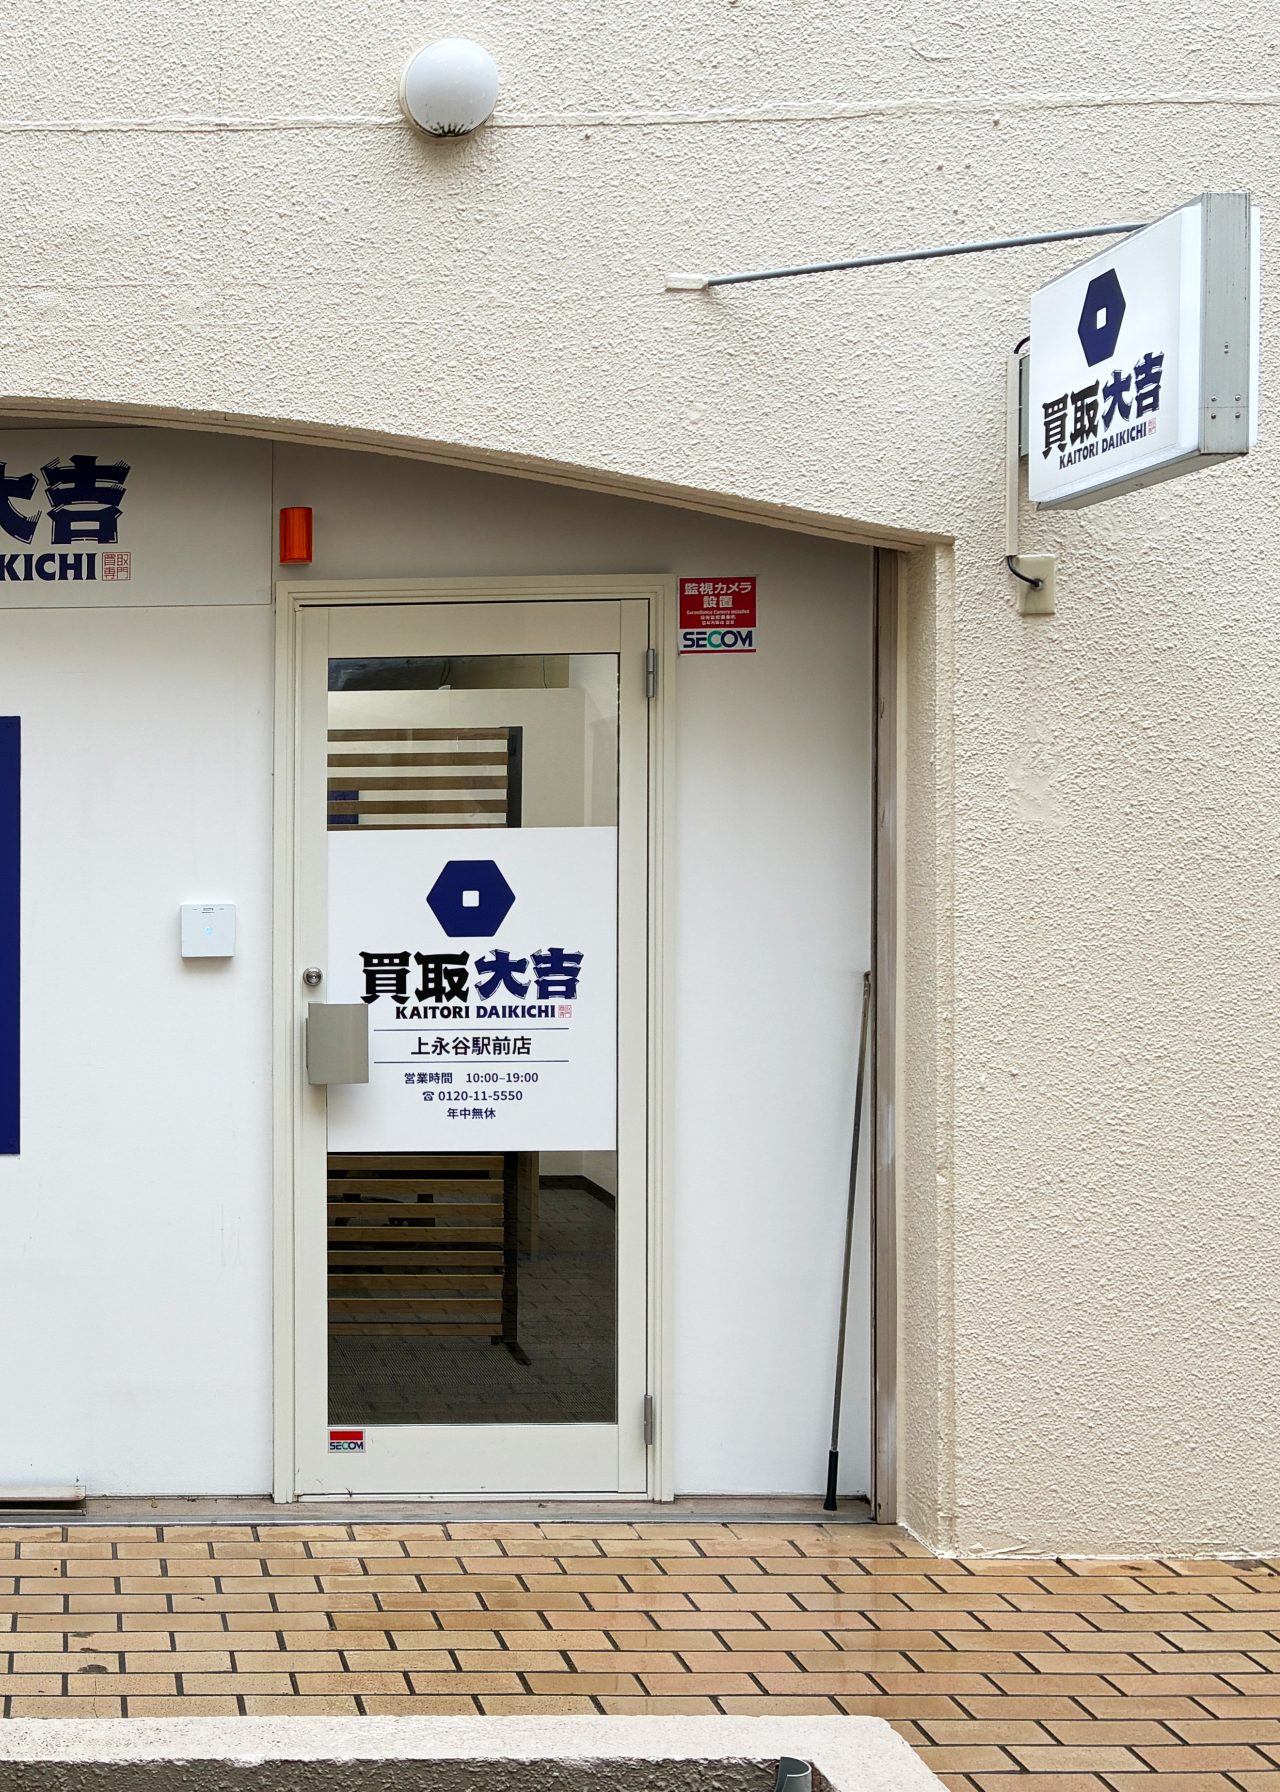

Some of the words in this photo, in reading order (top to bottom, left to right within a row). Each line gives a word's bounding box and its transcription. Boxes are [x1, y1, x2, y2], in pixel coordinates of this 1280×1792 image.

[1042, 350, 1165, 459] 買取大吉
[1059, 441, 1099, 470] KAITORI
[1102, 421, 1147, 454] DAIKICHI
[684, 582, 752, 595] 監視カメラ
[703, 595, 733, 608] 設置
[683, 630, 753, 648] SECOM
[359, 947, 585, 1005] 買取大吉
[395, 1005, 470, 1019] KAITORI
[476, 1004, 556, 1019] DAIKICHI
[410, 1036, 532, 1056] 上永谷駅前店
[404, 1072, 453, 1084] 営業時間
[438, 1090, 523, 1102] 0120-11-5550
[446, 1107, 497, 1120] 年中無休
[330, 1441, 364, 1450] SECOM
